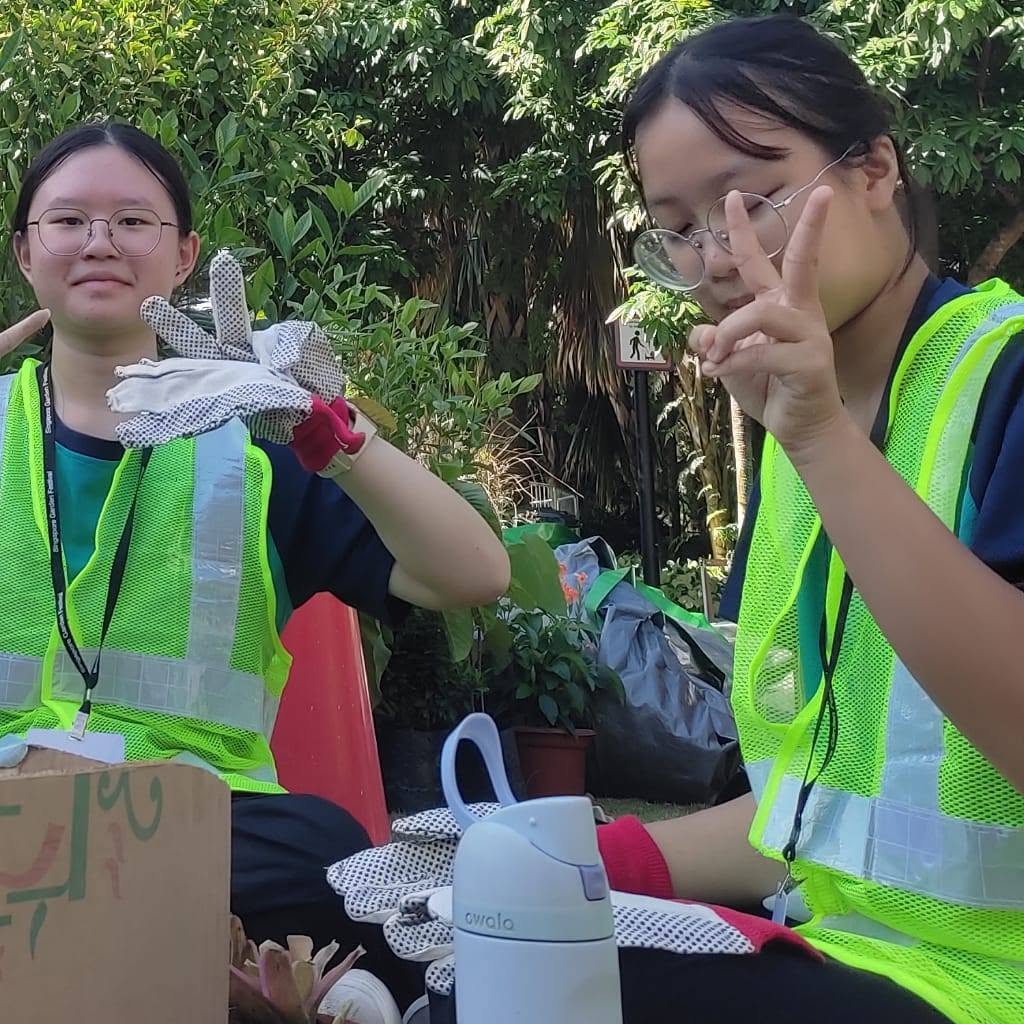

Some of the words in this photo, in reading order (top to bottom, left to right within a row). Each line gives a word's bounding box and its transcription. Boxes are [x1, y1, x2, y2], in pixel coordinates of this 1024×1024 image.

[48, 495, 56, 519] Garden
[51, 519, 59, 553] Singapore
[465, 912, 515, 931] owala
